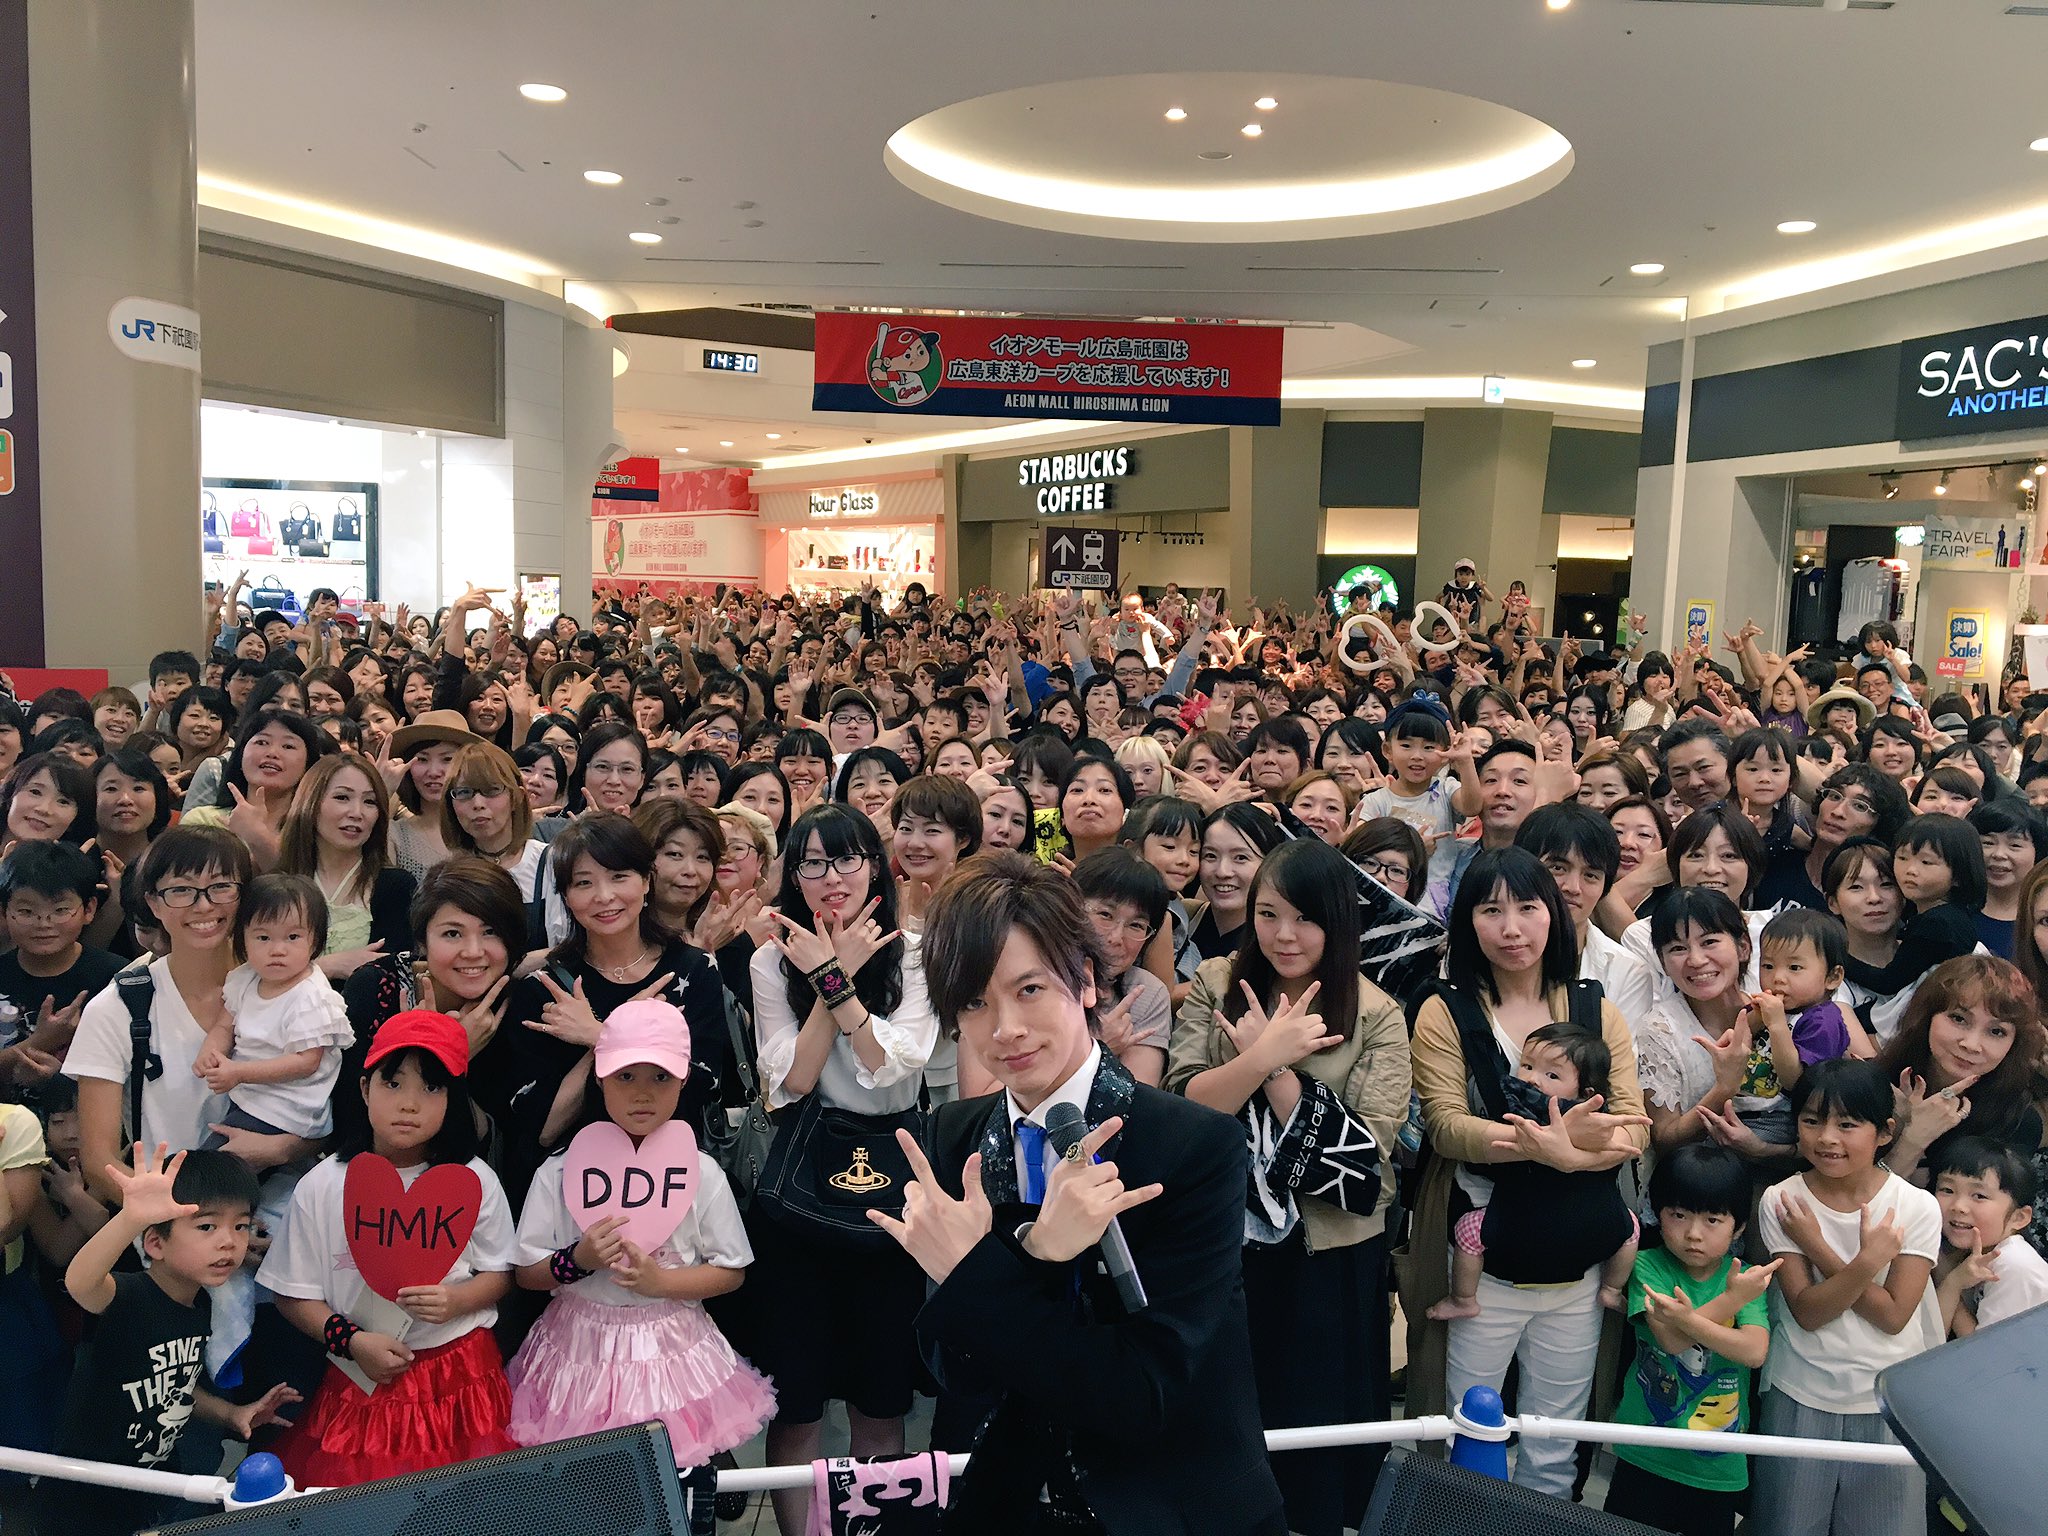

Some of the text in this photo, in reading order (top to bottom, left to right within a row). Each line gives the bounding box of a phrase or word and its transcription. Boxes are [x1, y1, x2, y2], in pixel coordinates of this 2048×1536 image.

[991, 334, 1189, 361] イオンモール広島祇園は
[711, 352, 757, 372] 14:30
[949, 359, 1230, 388] 広島東洋カープを応援しています!
[1005, 394, 1170, 413] AEON MALL HIROSHIMA GION
[1948, 385, 2048, 417] ANOTHE
[1019, 447, 1128, 485] STARBUCKS
[809, 492, 874, 513] Hour Glass
[1037, 482, 1105, 513] COFFEE
[1930, 530, 1993, 545] TRAVEL
[1930, 544, 1969, 558] FAIR!
[1949, 640, 1982, 658] Sale!
[1938, 661, 1964, 672] SALE
[581, 1166, 688, 1209] DDF
[354, 1204, 465, 1250] HMK
[148, 1336, 202, 1374] SING
